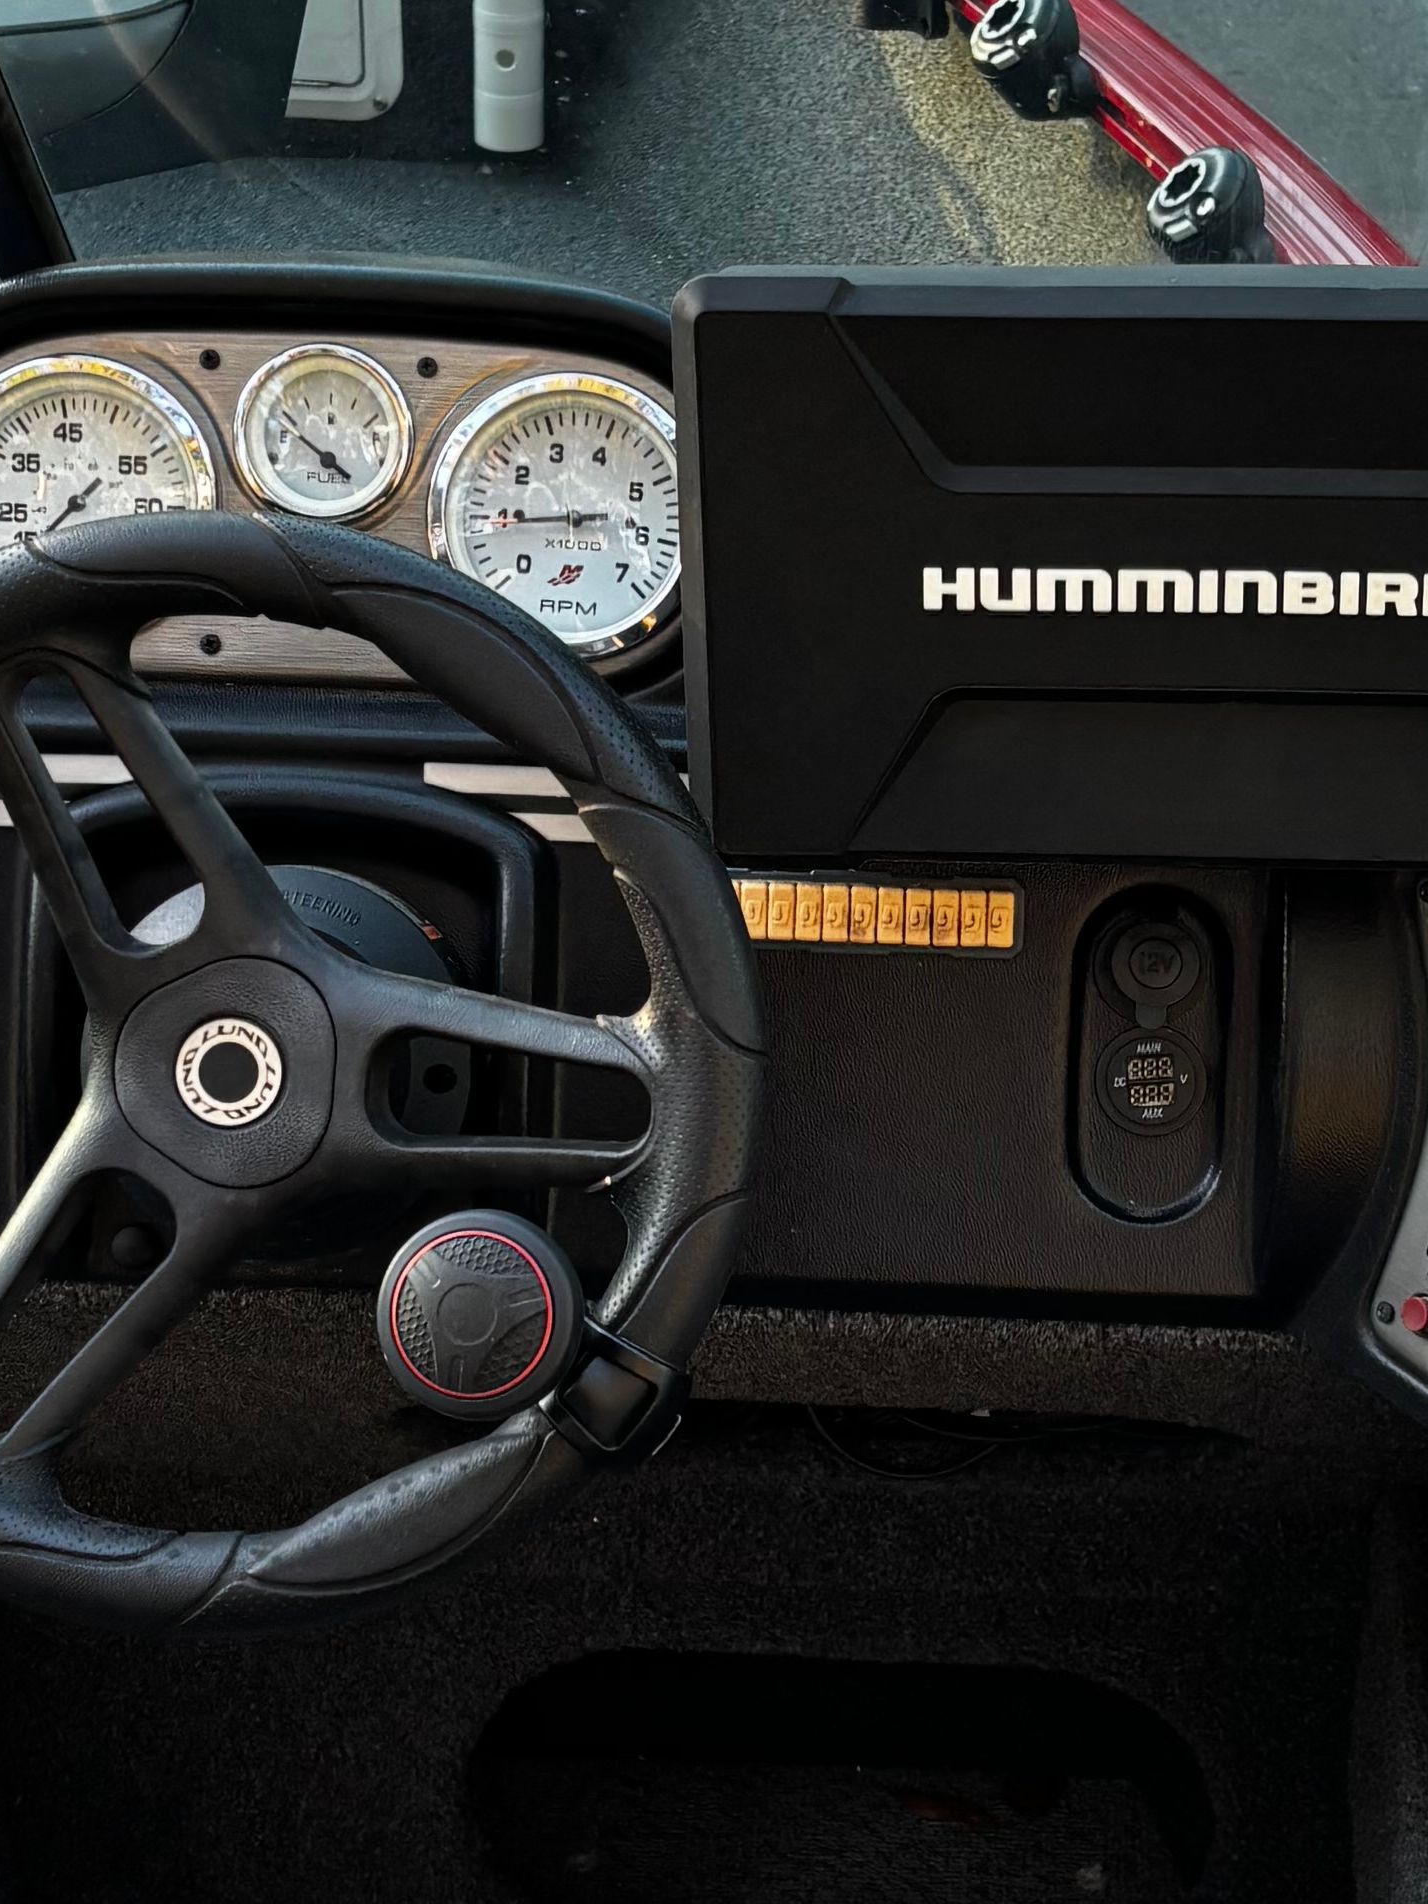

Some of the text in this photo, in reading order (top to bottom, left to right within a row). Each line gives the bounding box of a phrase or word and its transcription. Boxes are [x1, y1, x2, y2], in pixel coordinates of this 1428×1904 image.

[53, 422, 83, 443] 45
[11, 453, 41, 473] 35
[549, 443, 565, 463] 3
[592, 447, 607, 467] 4
[118, 455, 148, 476] 55
[514, 465, 530, 485] 2
[628, 481, 644, 502] 5
[635, 526, 650, 546] 6
[516, 553, 532, 574] 0
[615, 562, 630, 583] 7
[539, 599, 598, 616] RPM
[201, 1025, 268, 1059] LUND
